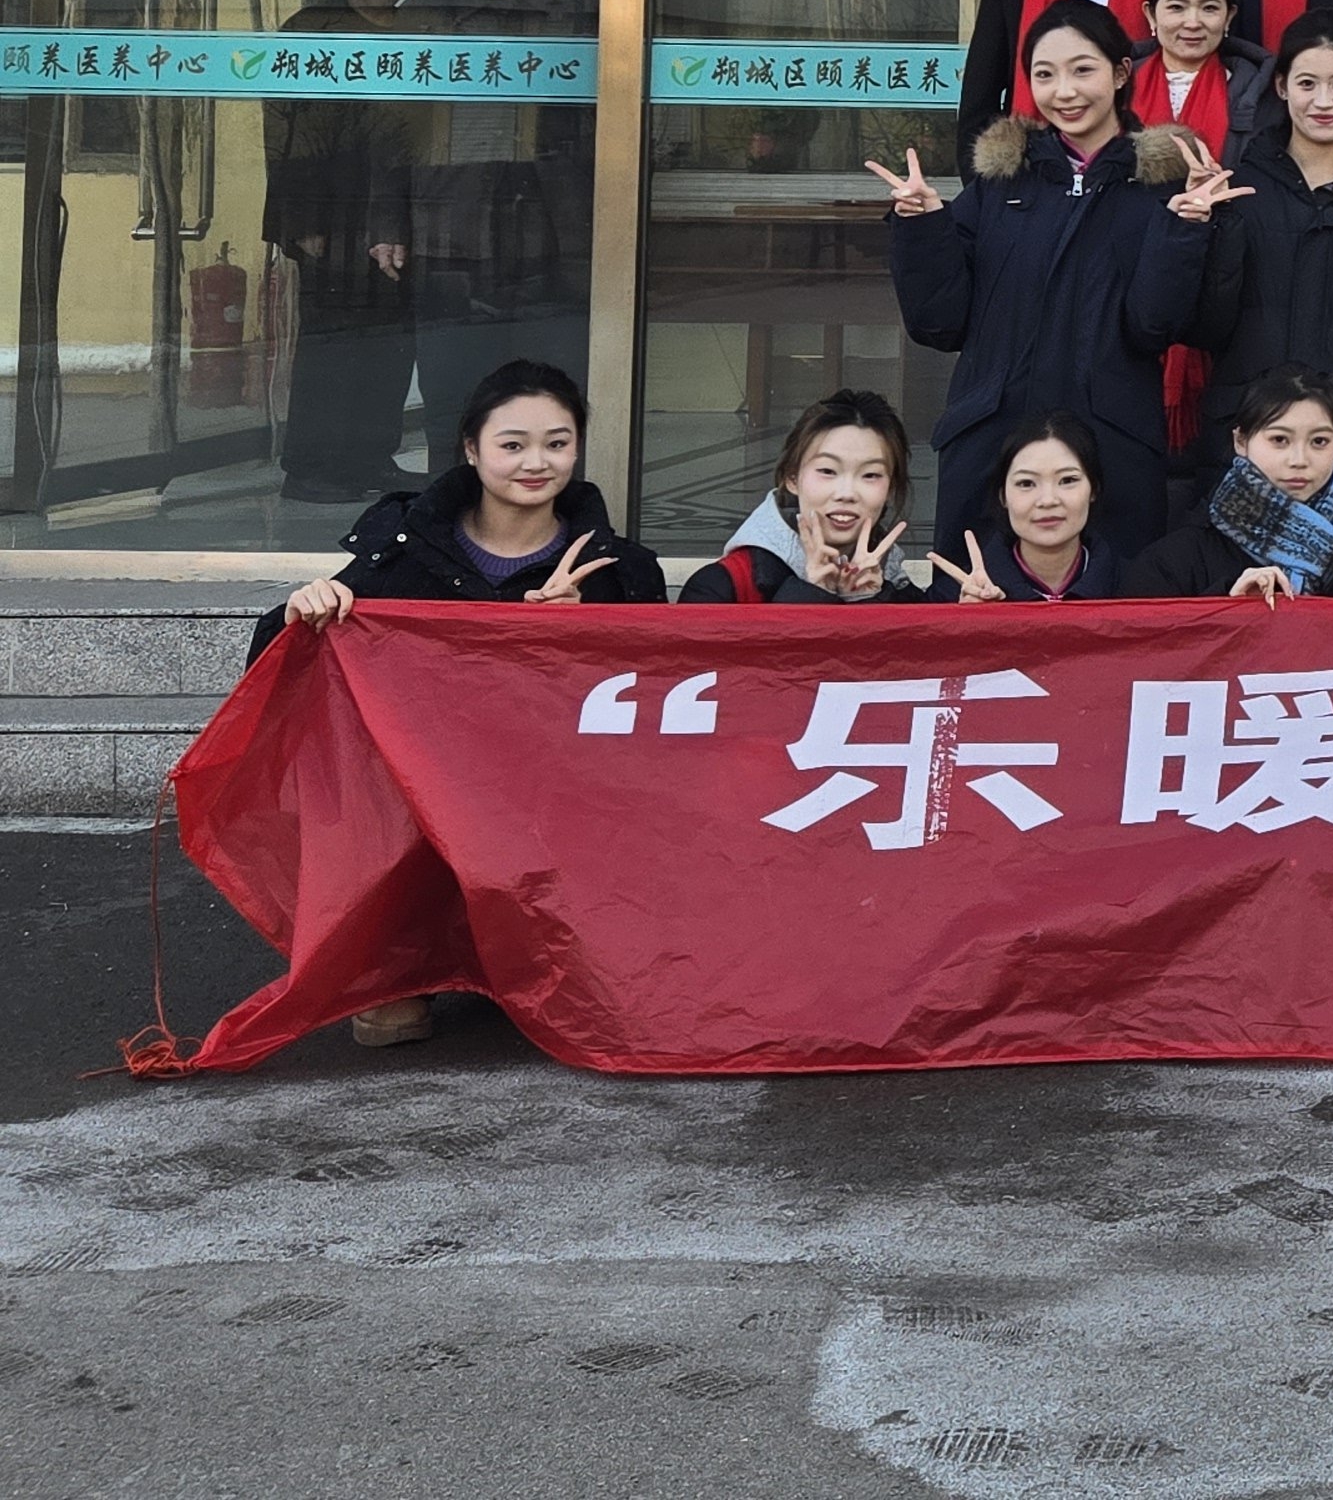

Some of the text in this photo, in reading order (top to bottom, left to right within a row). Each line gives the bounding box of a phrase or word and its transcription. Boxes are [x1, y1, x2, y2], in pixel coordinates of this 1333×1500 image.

[3, 41, 209, 81] 颐养医养中心
[270, 48, 580, 87] 朔城区颐养医养中心
[711, 55, 965, 95] 朔城区颐养医养
